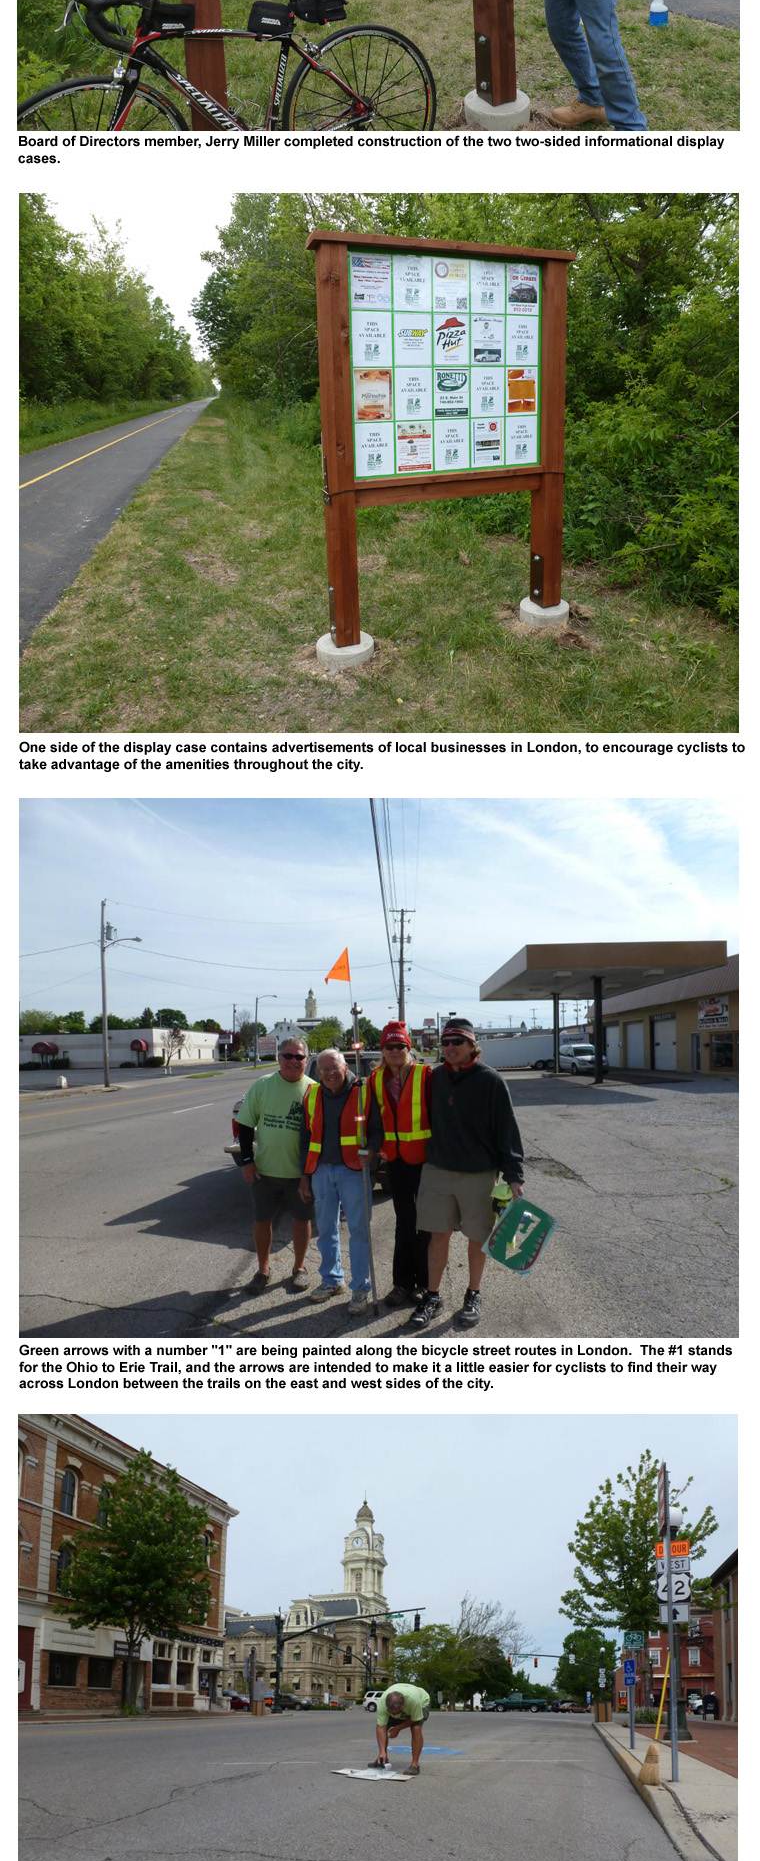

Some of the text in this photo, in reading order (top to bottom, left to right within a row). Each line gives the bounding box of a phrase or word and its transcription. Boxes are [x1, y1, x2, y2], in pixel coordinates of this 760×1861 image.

[274, 53, 287, 106] SPECIALIZED
[172, 73, 242, 131] SPECIALIZE
[398, 329, 428, 338] SUBWAY
[437, 330, 466, 346] Pizza
[442, 338, 462, 350] Hut
